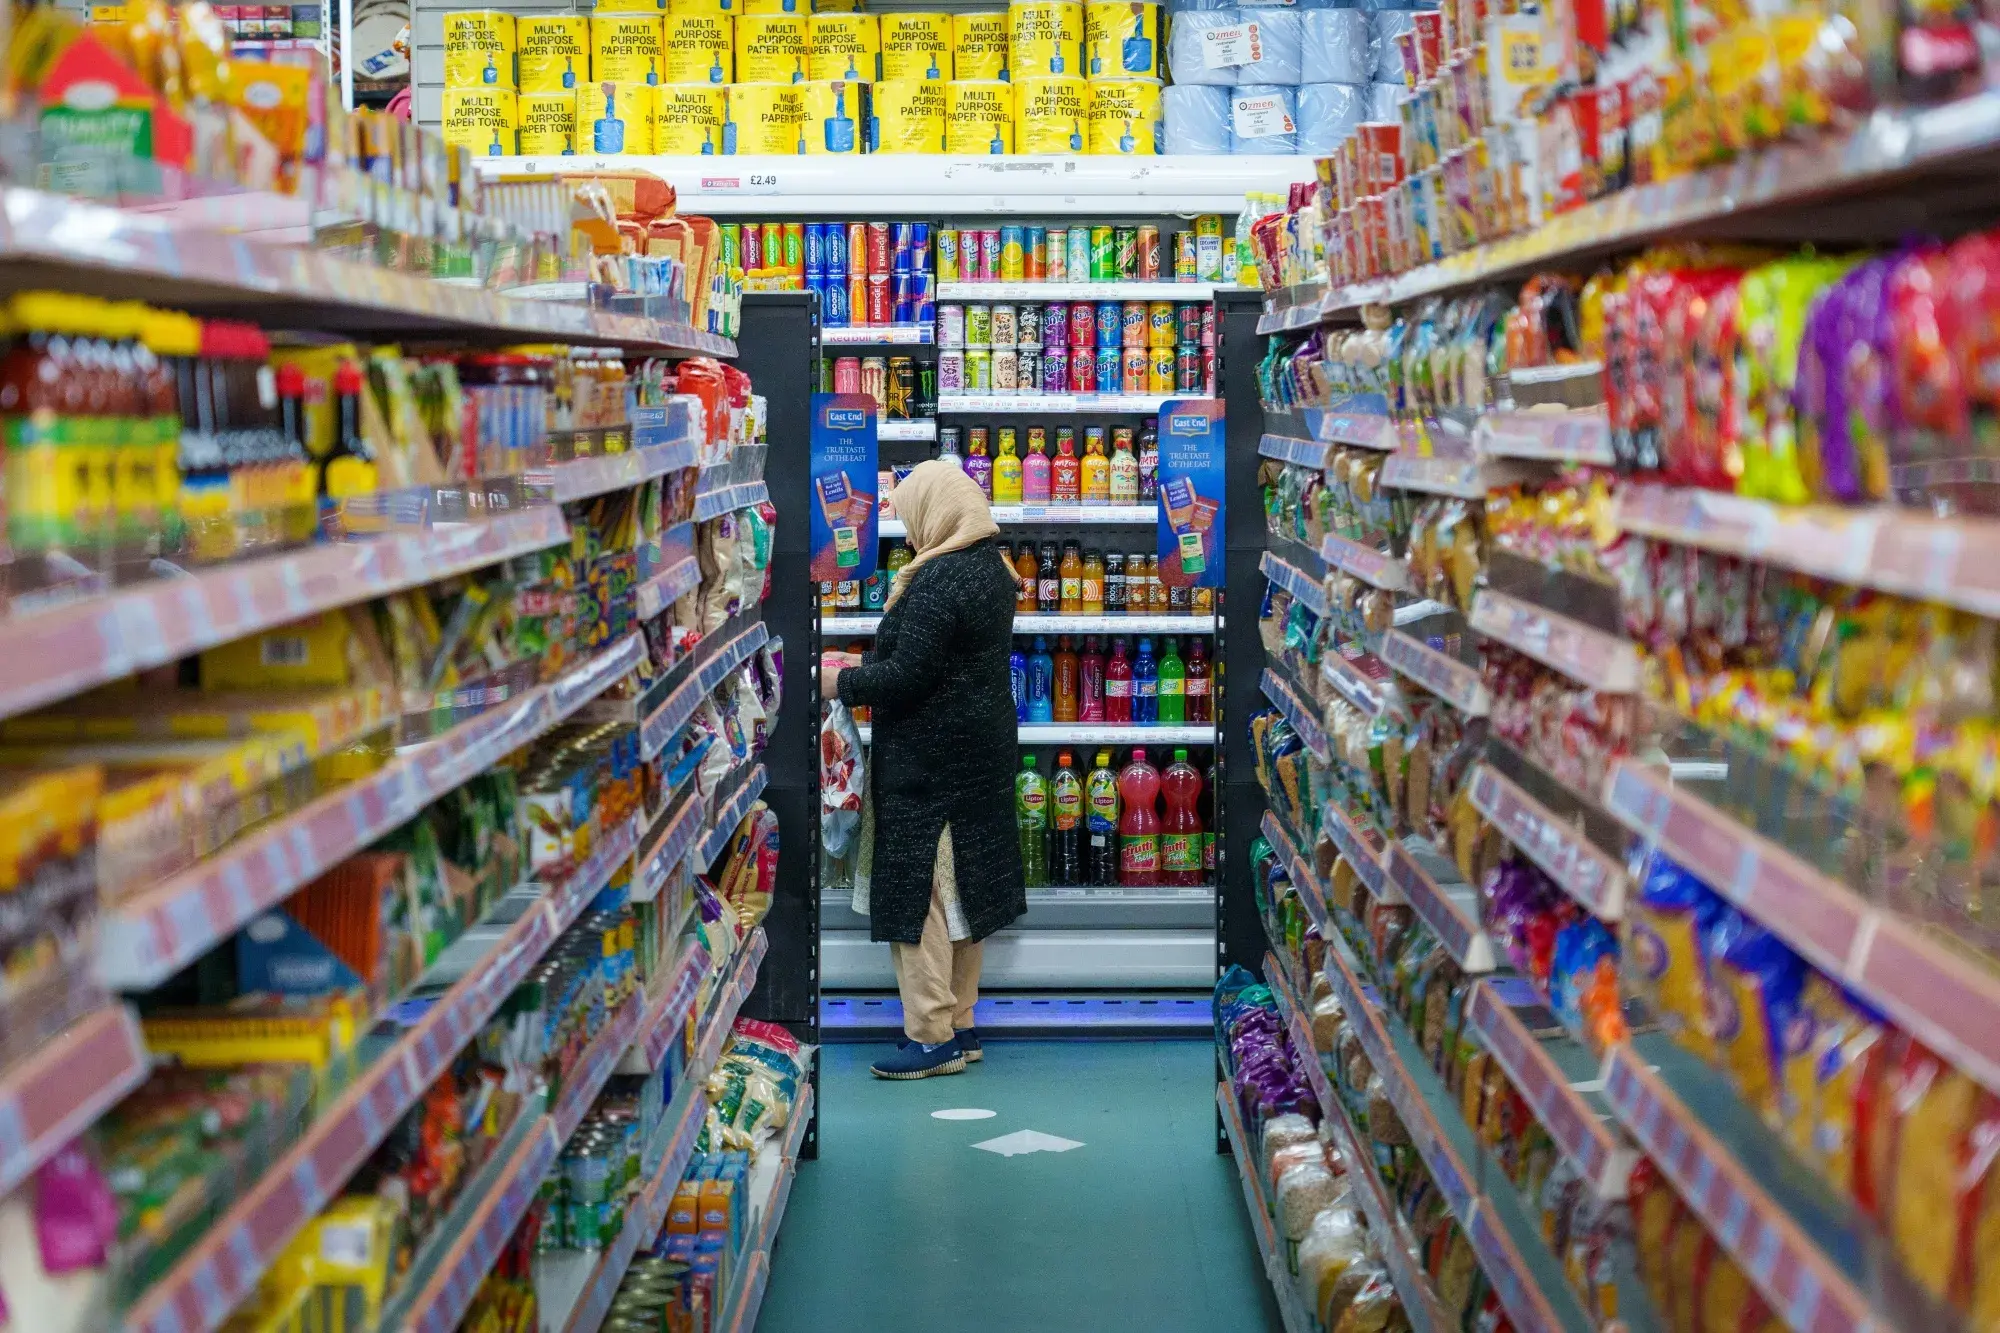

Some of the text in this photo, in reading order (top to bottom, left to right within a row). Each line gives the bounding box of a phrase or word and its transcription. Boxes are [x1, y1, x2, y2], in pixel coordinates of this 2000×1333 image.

[455, 21, 486, 30] MULTI
[682, 19, 714, 28] MULTI
[898, 21, 930, 30] MULTI
[970, 22, 1002, 32] MULTI
[534, 26, 565, 34] MULTI
[619, 25, 650, 34] MULTI
[766, 24, 796, 34] MULTI
[818, 24, 848, 34] MULTI
[449, 31, 495, 40] PURPOSE
[674, 30, 722, 39] PURPOSE
[812, 34, 857, 44] PURPOSE
[891, 32, 939, 41] PURPOSE
[964, 33, 1008, 42] PURPOSE
[1040, 31, 1073, 40] TOWEL
[526, 36, 574, 45] PURPOSE
[611, 36, 656, 45] PURPOSE
[668, 40, 730, 50] PAPER TOWEL
[758, 35, 803, 45] PURPOSE
[472, 41, 505, 51] TOWEL
[552, 46, 582, 55] TOWEL
[602, 46, 632, 56] PAPER
[748, 45, 780, 54] PAPER
[833, 44, 867, 54] TOWEL
[884, 42, 948, 52] PAPER TOWEL
[956, 43, 1008, 54] PAPER TOW
[1042, 86, 1074, 96] MULTI
[1095, 90, 1125, 99] MULTI
[461, 97, 493, 106] MULTI
[675, 94, 706, 104] MULTI
[964, 92, 996, 101] MULTI
[1034, 96, 1080, 106] PURPOSE
[532, 104, 564, 112] MULTI
[666, 104, 714, 115] PURPOSE
[956, 102, 1003, 112] PURPOSE
[1090, 100, 1134, 110] PURPOSE
[454, 108, 502, 118] PURPOSE
[901, 106, 932, 116] PAPER
[1024, 108, 1088, 119] PAPER TOWEL
[526, 114, 574, 124] PURPOSE
[658, 114, 688, 124] PAPER
[692, 115, 720, 126] TOWEL
[948, 112, 1012, 123] PAPER TOWEL
[446, 118, 510, 128] PAPER TOWEL
[550, 123, 576, 133] TOW
[750, 175, 776, 185] £2.49
[1122, 313, 1144, 327] anta
[1097, 360, 1118, 374] anta
[830, 412, 862, 420] East End
[1174, 418, 1206, 427] East End
[825, 487, 844, 496] Lentils
[1170, 493, 1188, 502] Lentils
[1134, 852, 1154, 862] Fresh
[1168, 850, 1188, 862] Fresh
